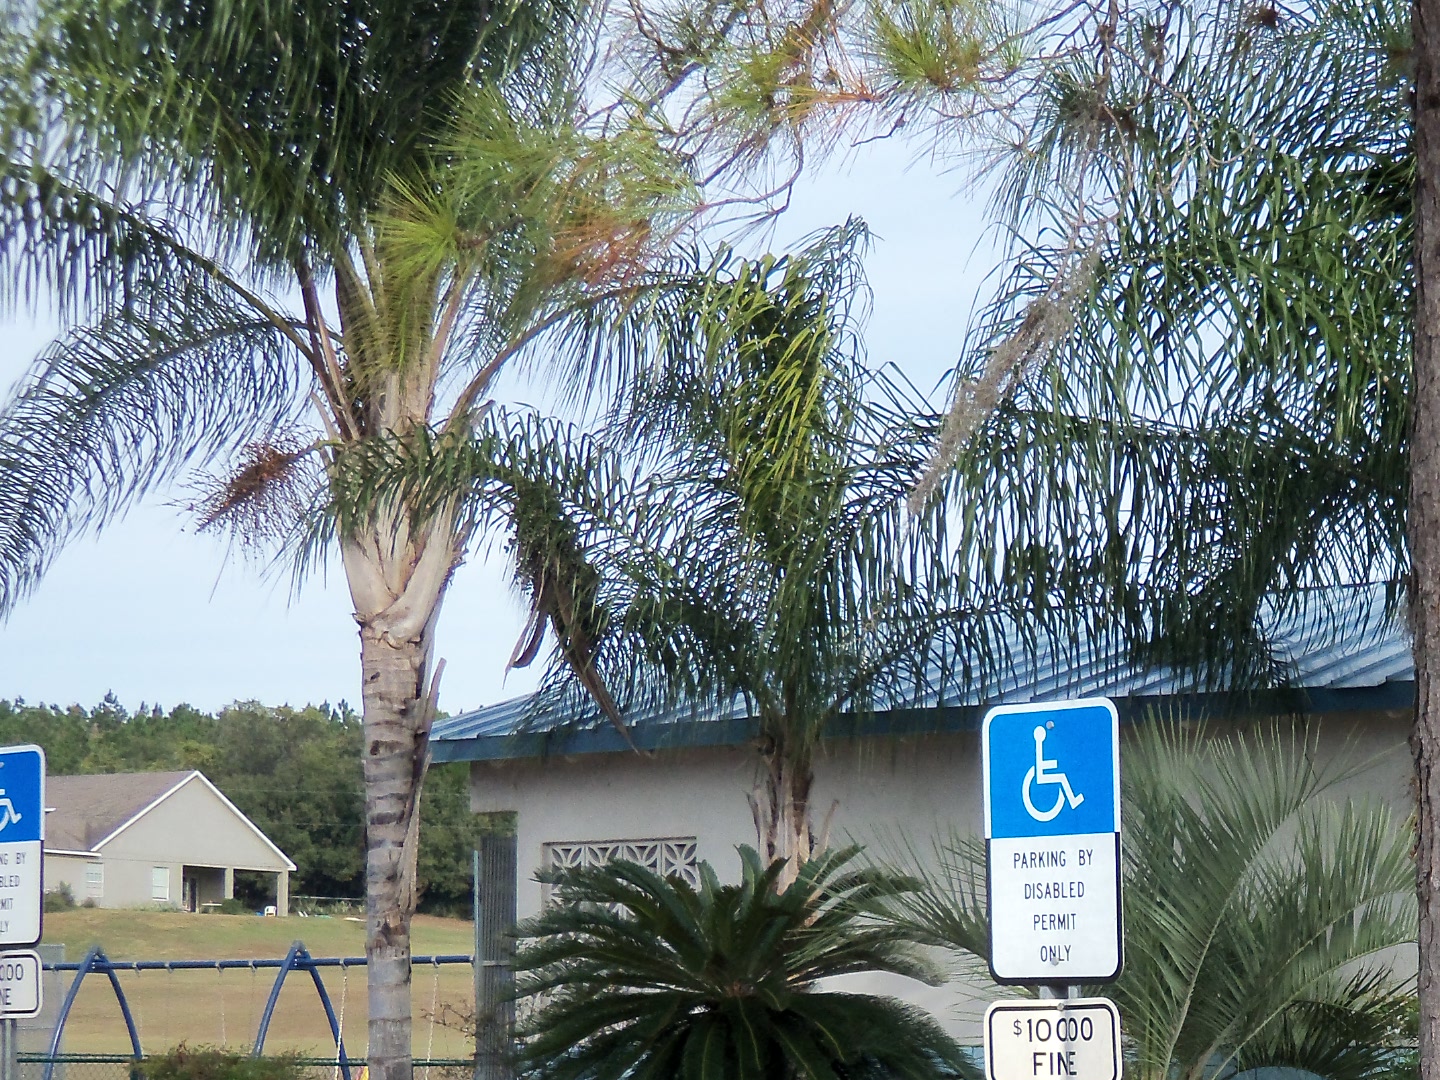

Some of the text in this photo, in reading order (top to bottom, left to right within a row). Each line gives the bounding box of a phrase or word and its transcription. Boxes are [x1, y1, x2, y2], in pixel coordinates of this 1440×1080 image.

[16, 852, 26, 865] BY
[1013, 848, 1093, 869] PARKING BY
[1024, 881, 1085, 900] DISABLED
[1033, 913, 1076, 931] PERMIT
[1040, 945, 1071, 963] ONLY
[1033, 1051, 1077, 1076] FINE
